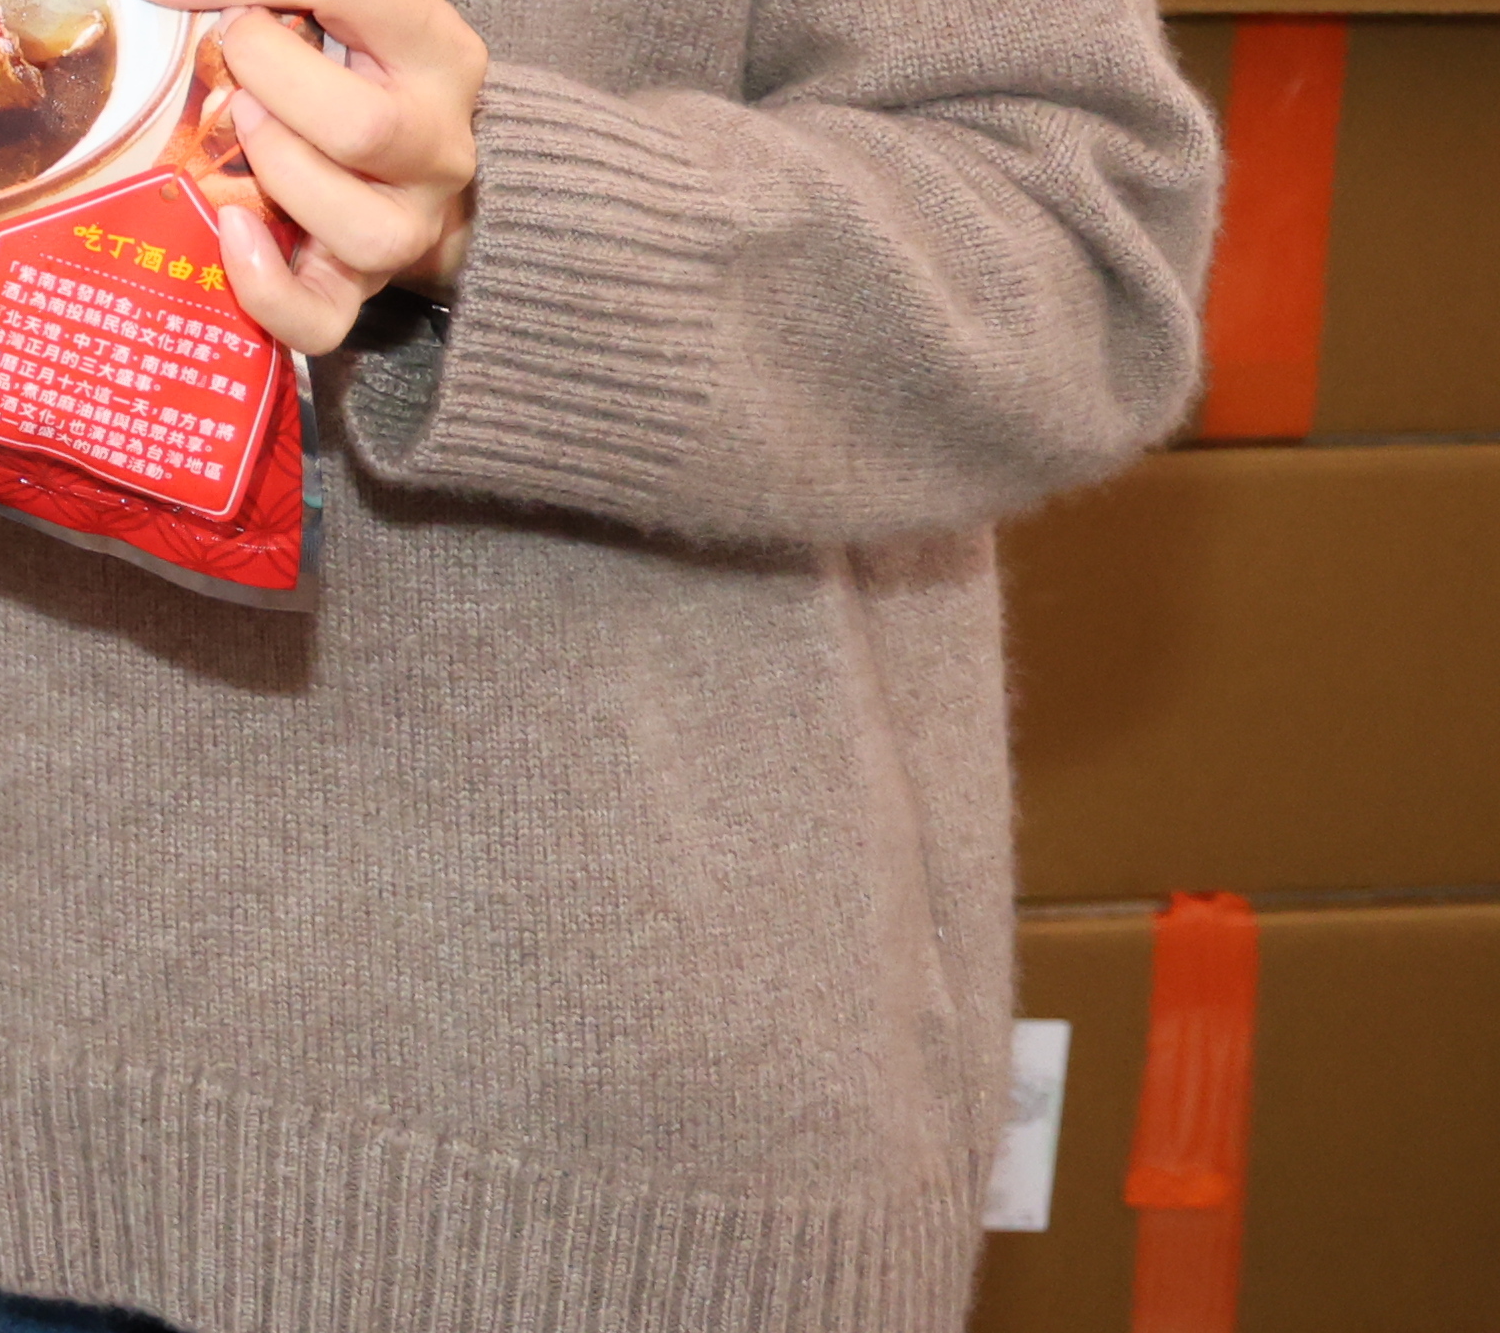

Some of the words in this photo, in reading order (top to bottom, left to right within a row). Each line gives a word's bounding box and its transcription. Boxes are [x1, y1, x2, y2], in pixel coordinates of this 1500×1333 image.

[73, 223, 226, 292] 吃丁酒由來
